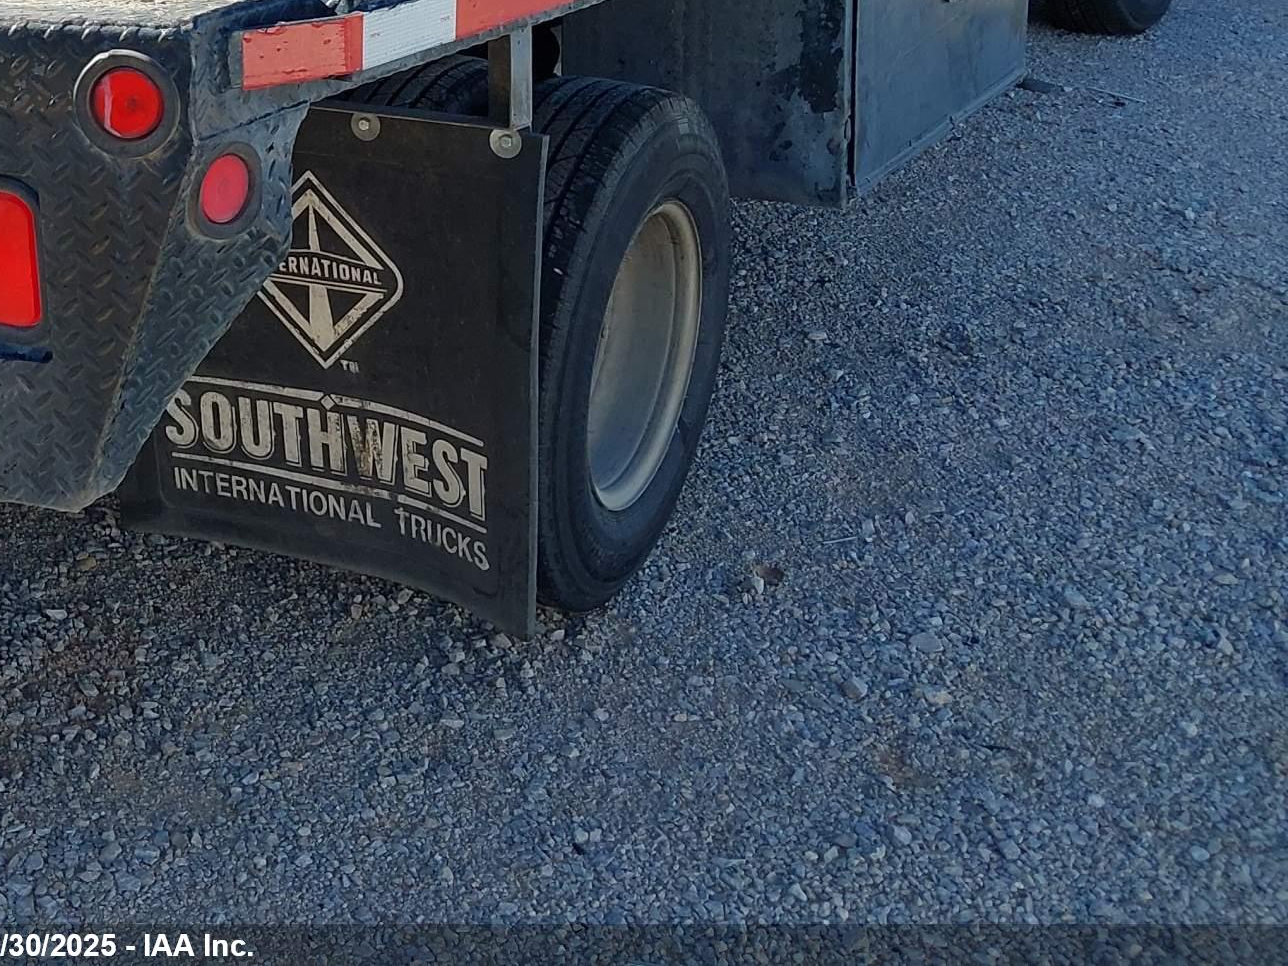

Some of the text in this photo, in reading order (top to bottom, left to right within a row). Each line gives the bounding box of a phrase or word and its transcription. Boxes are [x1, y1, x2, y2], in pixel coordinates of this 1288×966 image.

[278, 256, 383, 286] ERNATIONAL
[165, 388, 489, 522] SOUTHWEST
[174, 466, 490, 571] INTERNATIONAL TRUCKS
